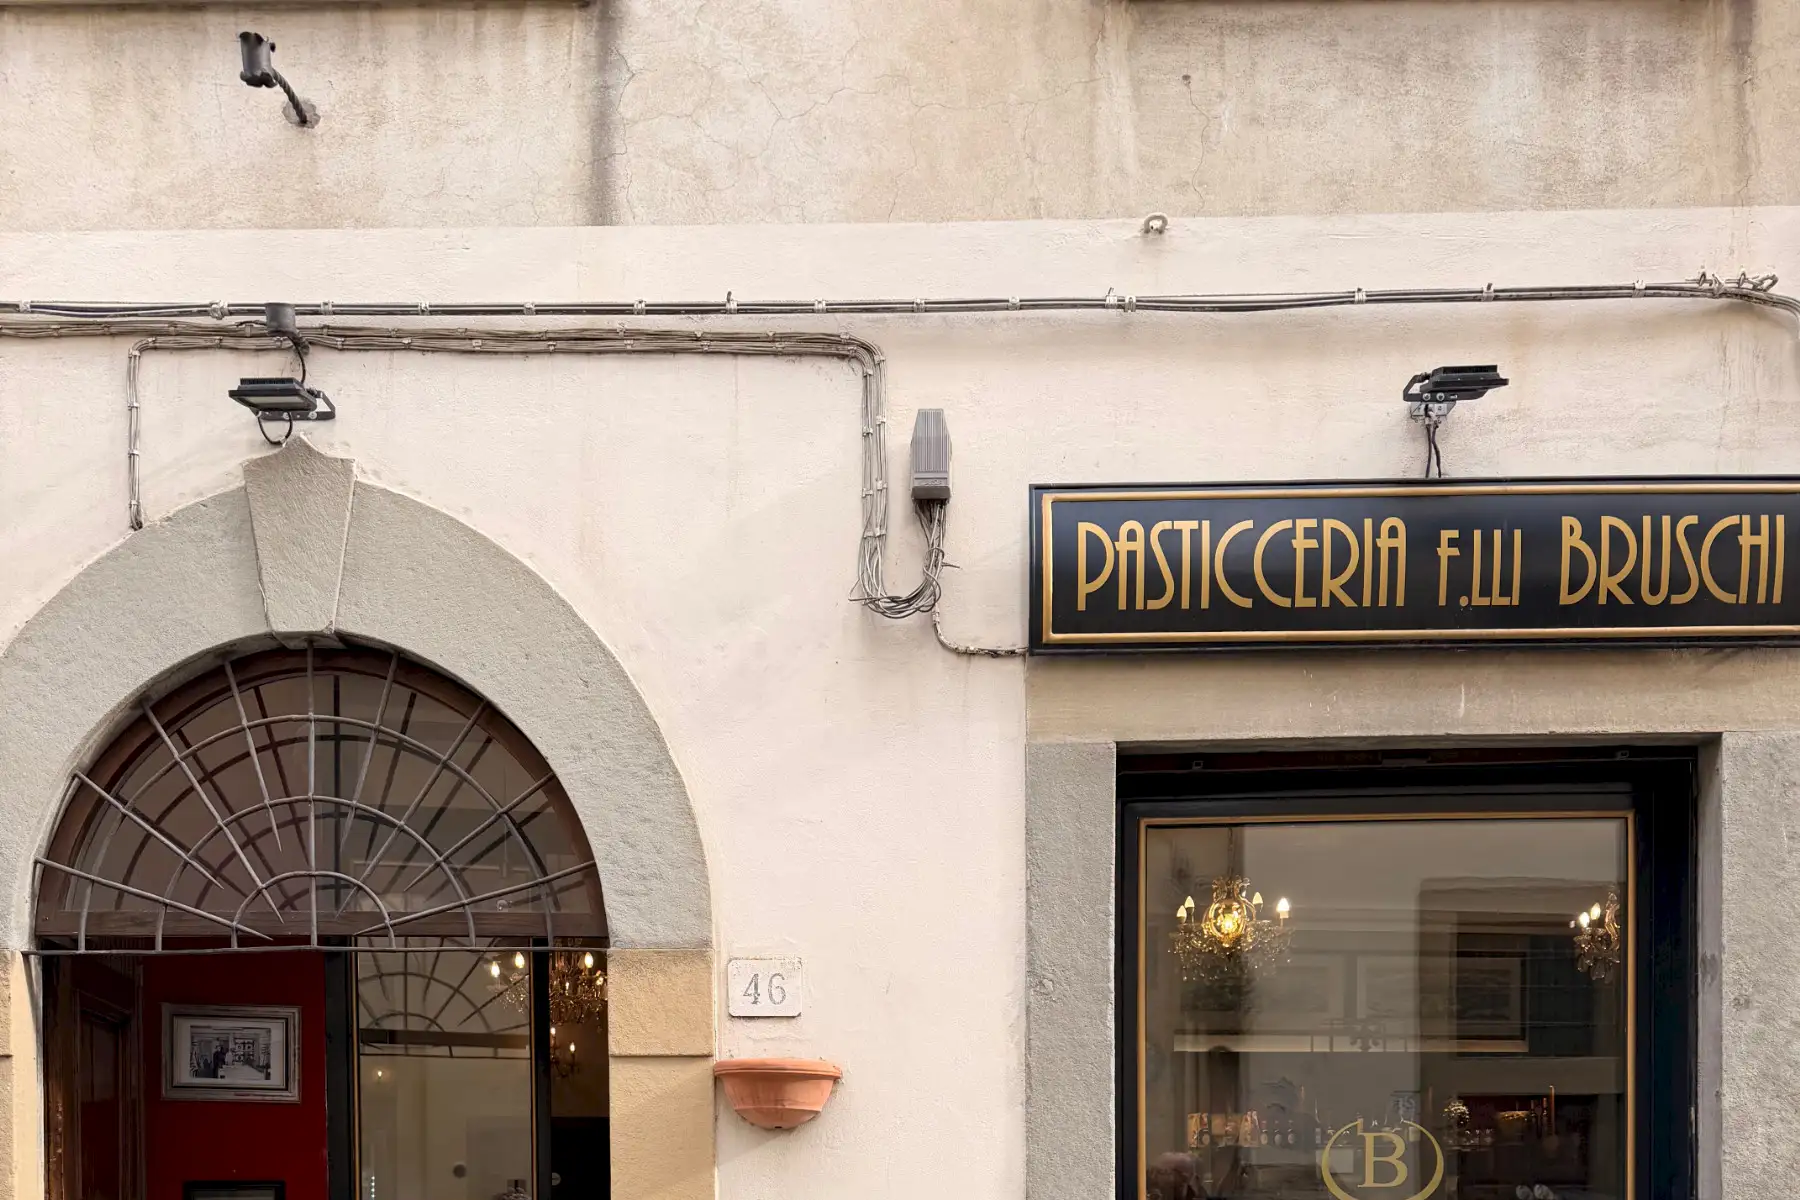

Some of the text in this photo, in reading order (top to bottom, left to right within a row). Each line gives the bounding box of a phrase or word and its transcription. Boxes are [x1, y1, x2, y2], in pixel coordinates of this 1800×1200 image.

[1076, 514, 1785, 611] PASTICCERIA F.LLI BRUSCHI
[743, 972, 787, 1005] 46
[1357, 1132, 1408, 1188] B
